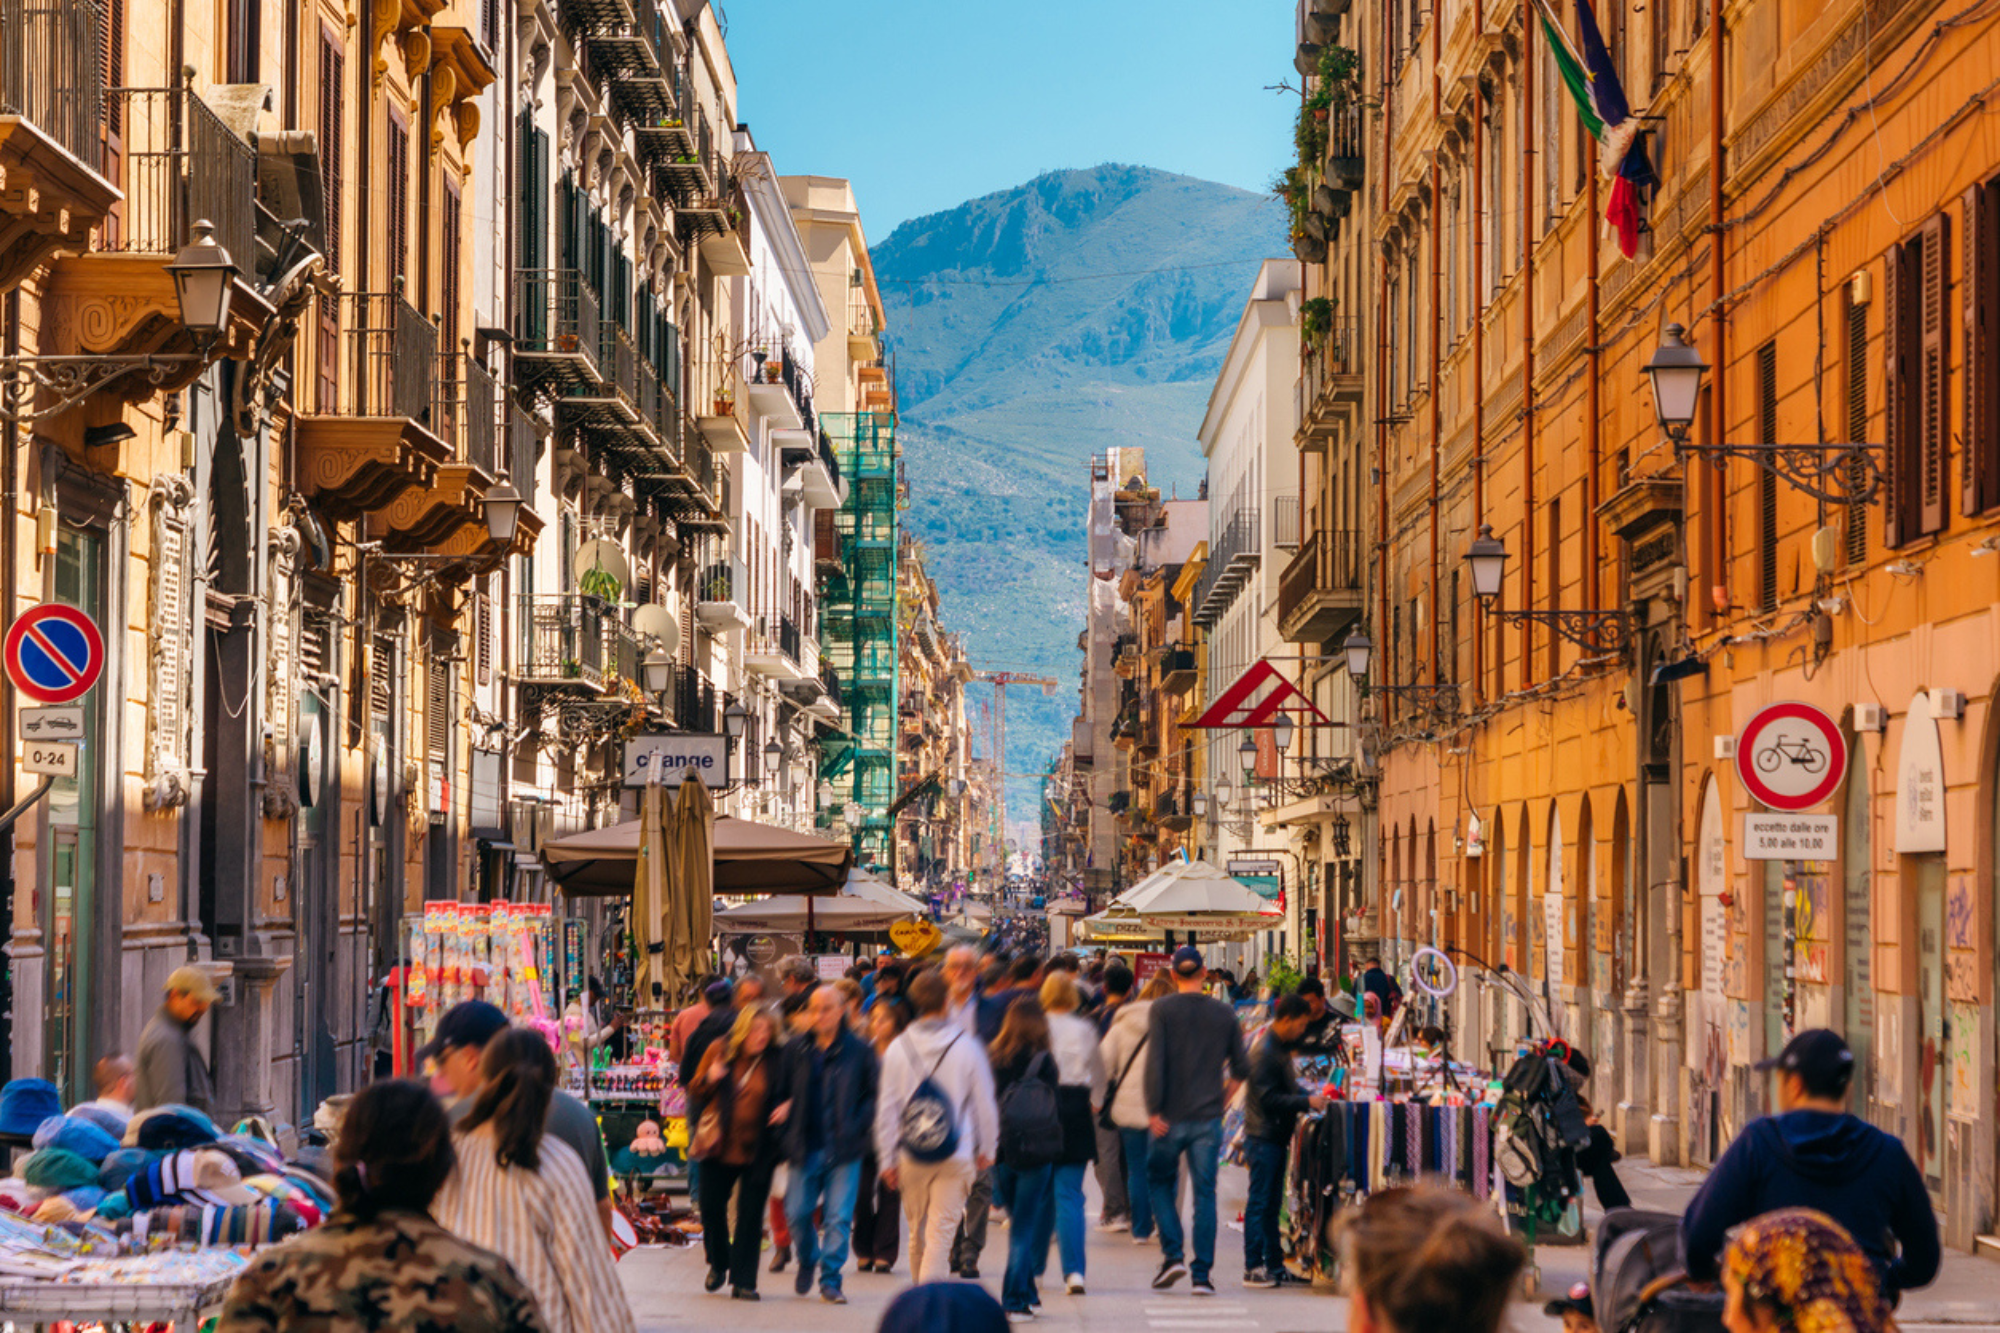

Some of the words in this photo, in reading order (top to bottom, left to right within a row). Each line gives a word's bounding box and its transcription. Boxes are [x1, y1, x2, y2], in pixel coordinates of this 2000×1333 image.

[33, 750, 66, 766] 0-24
[636, 750, 714, 769] cange
[1753, 822, 1787, 833] eccetto
[1789, 822, 1812, 833] dalle
[1814, 824, 1829, 833] ore
[1780, 837, 1796, 849] alle
